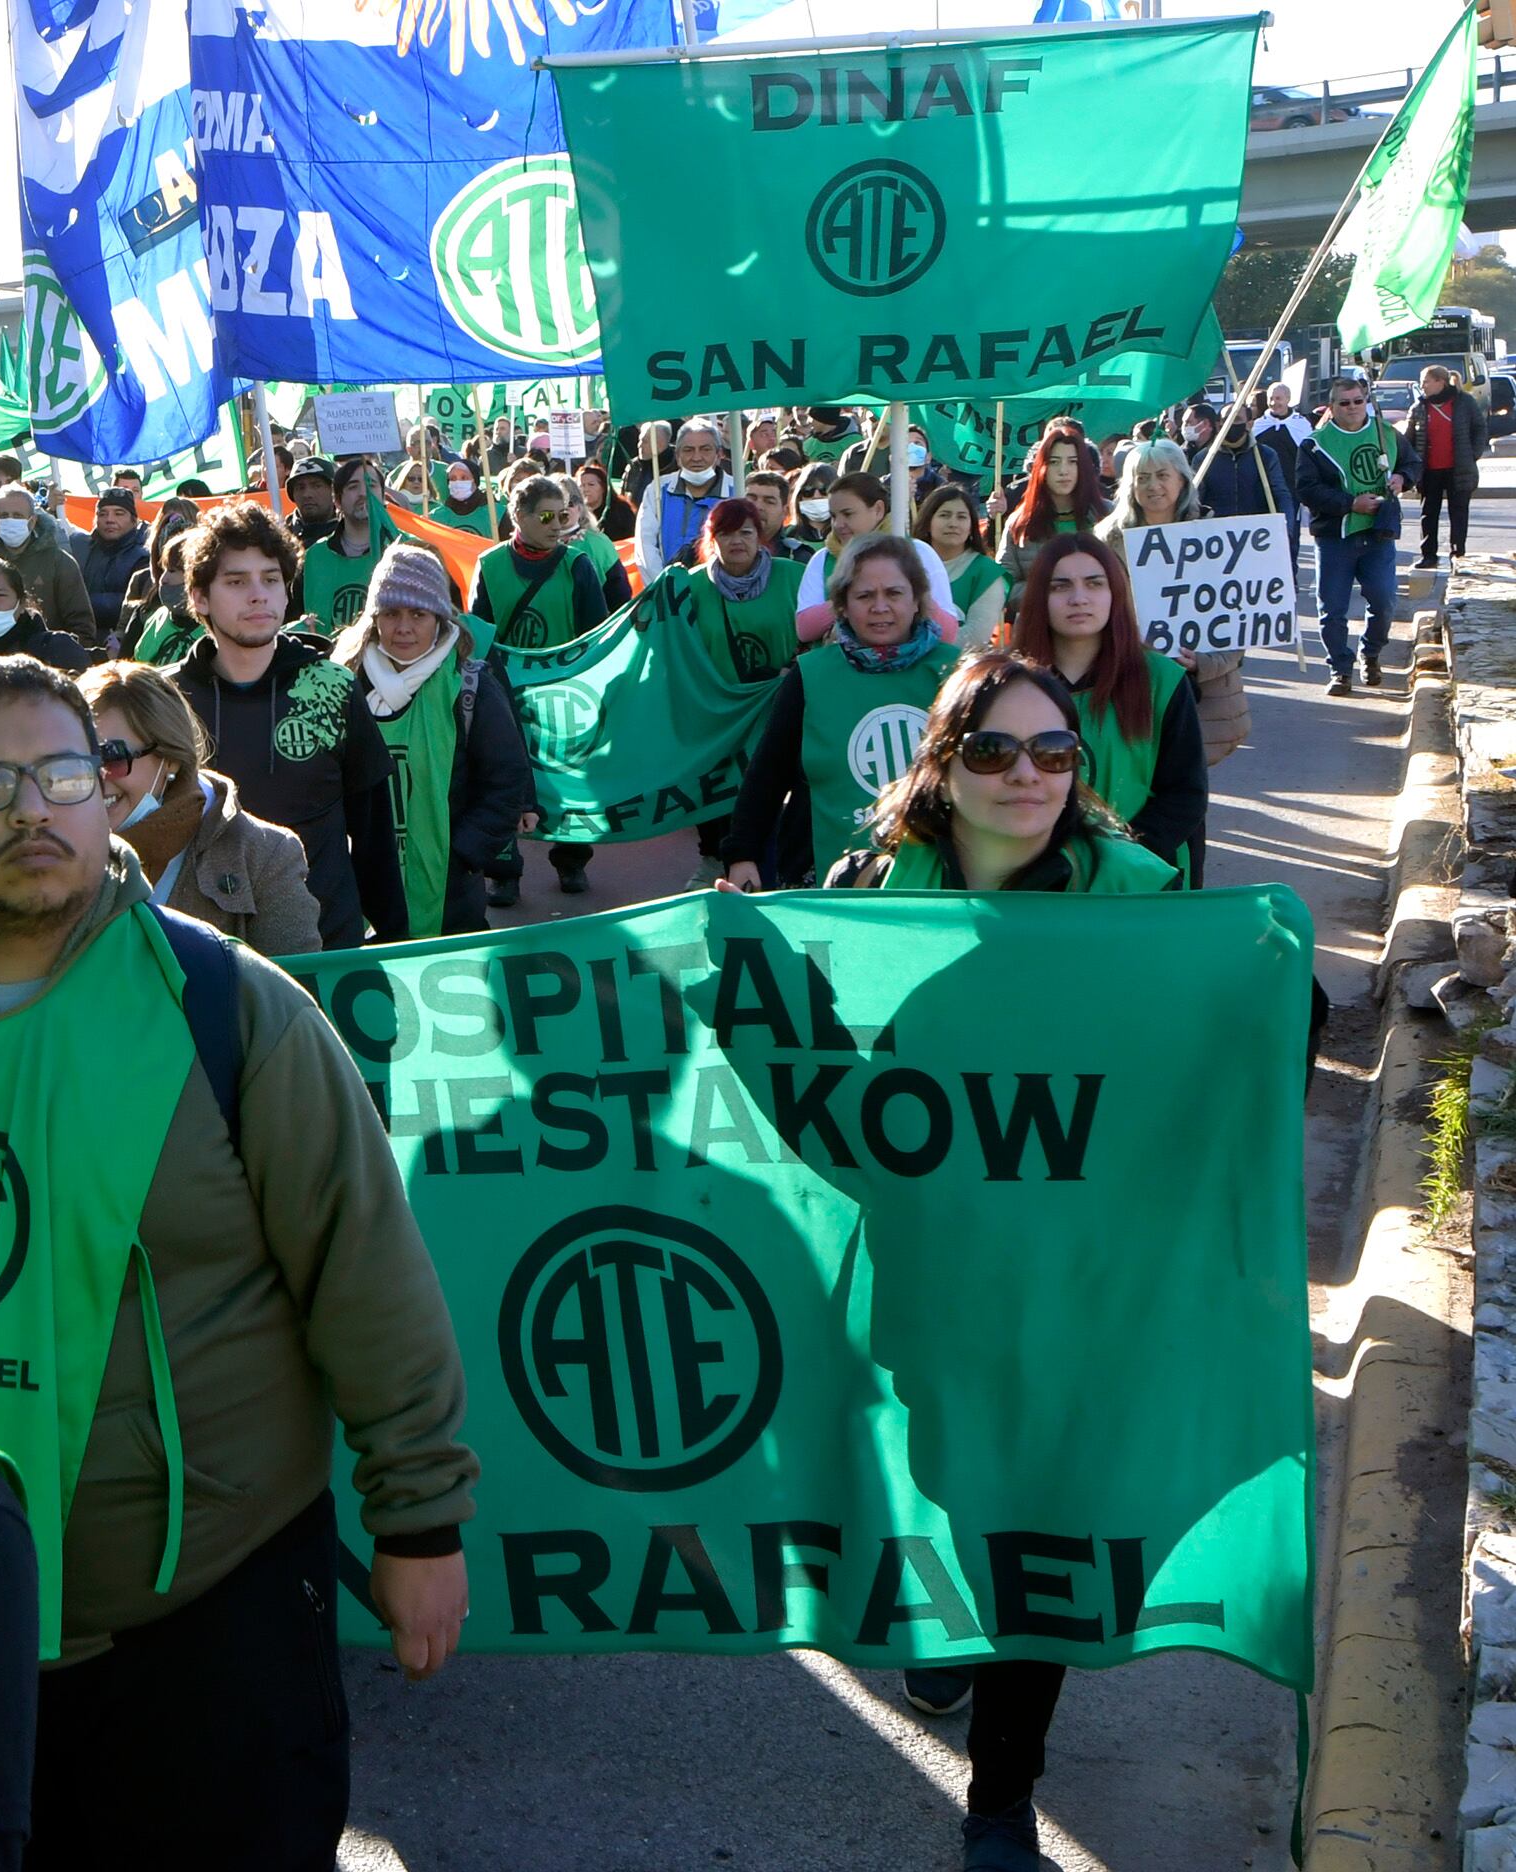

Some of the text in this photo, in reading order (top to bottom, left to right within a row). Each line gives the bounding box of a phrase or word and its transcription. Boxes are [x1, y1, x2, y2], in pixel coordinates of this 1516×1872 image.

[749, 55, 1044, 132] DINAF
[822, 175, 928, 282] ATE
[645, 303, 1166, 401] SAN RAFAEL
[326, 406, 388, 419] AUMENTO DE
[328, 420, 390, 433] EMERGENCIA
[1136, 526, 1272, 581] Apoye
[497, 1520, 1226, 1648] RAFAEL
